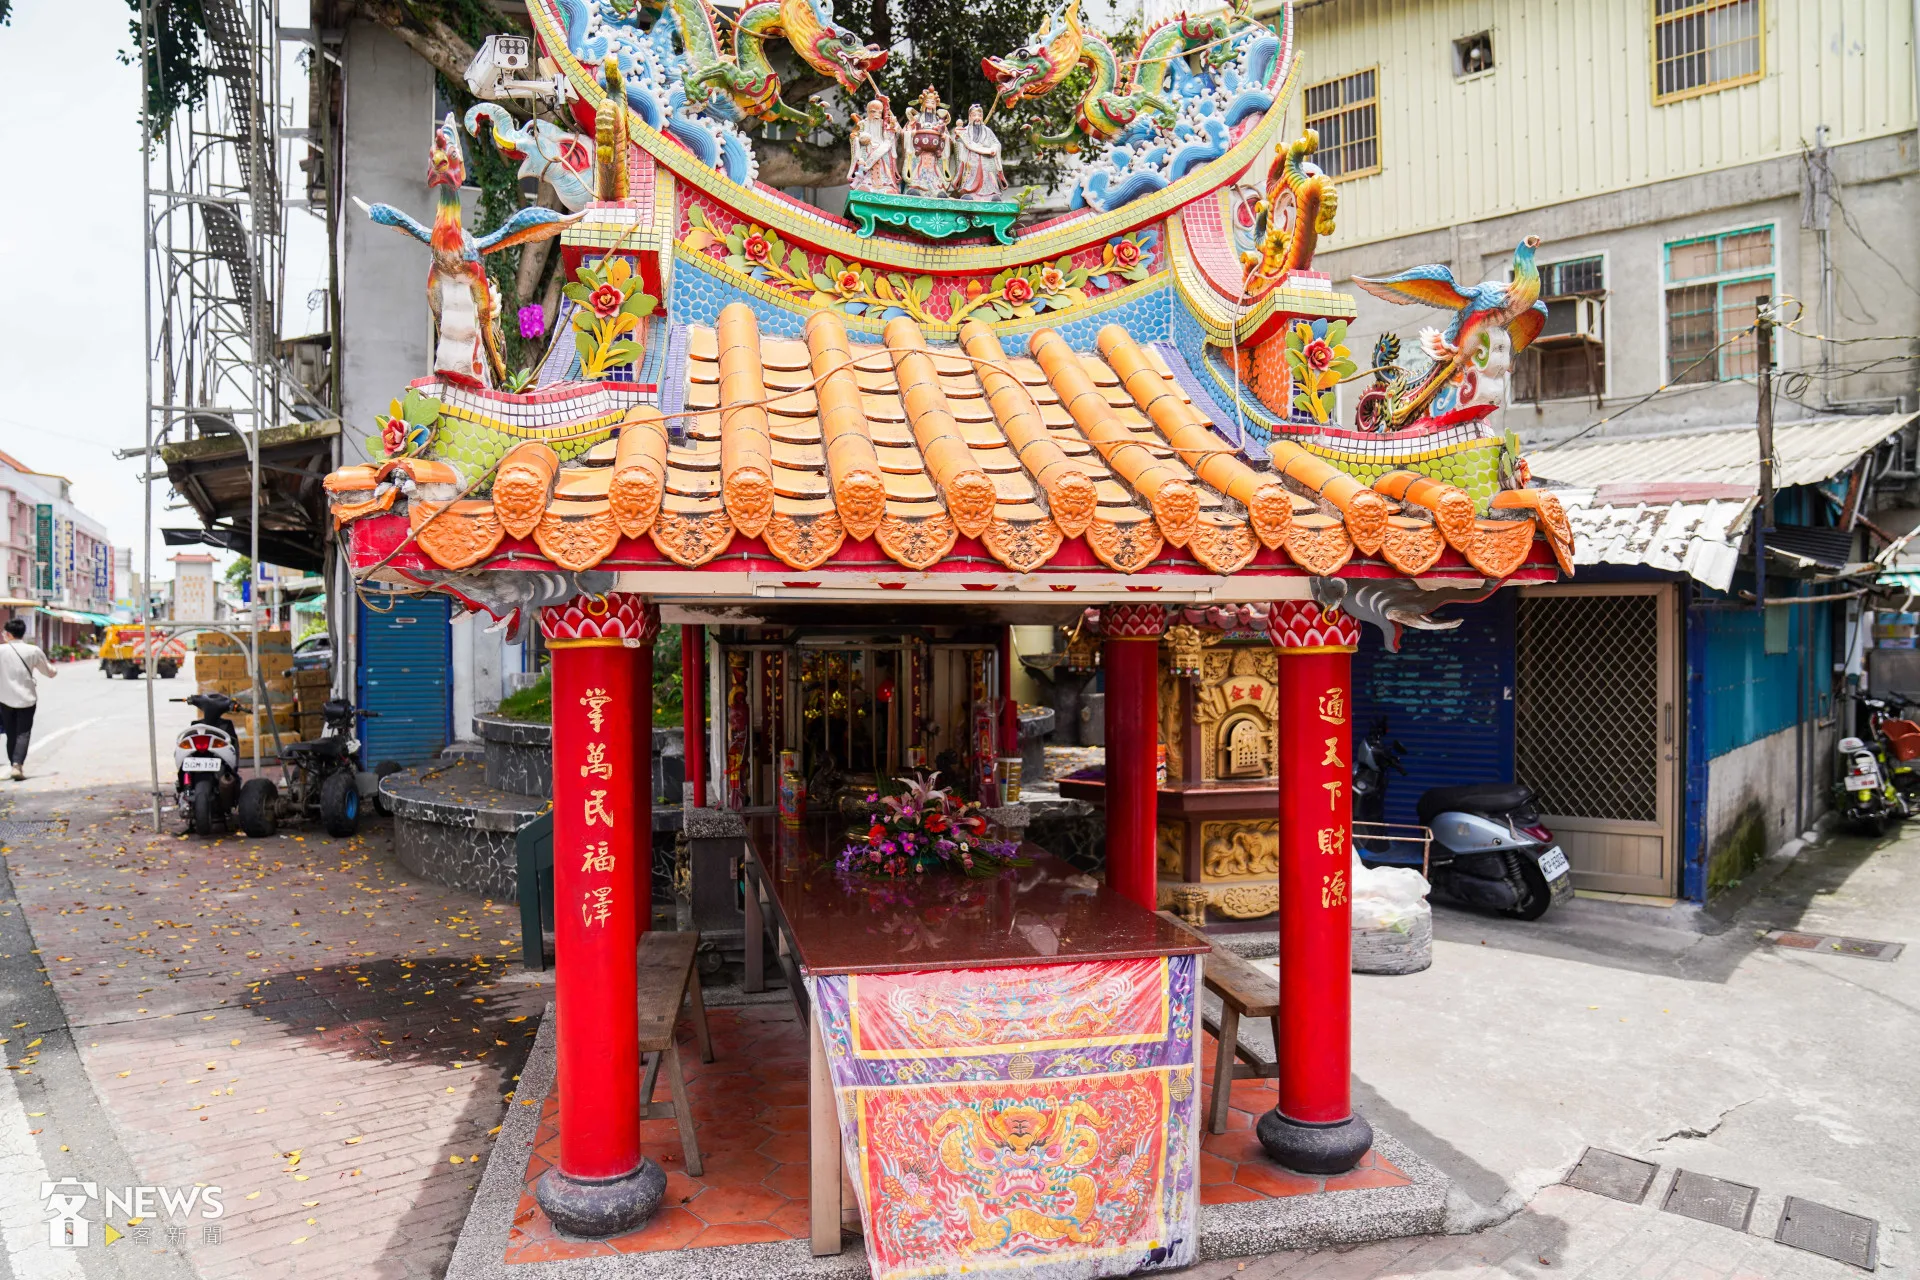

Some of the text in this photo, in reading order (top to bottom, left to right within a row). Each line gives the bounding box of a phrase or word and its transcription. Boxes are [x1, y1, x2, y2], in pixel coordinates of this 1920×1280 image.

[579, 688, 616, 929] 掌萬民福澤
[1317, 687, 1348, 909] 通天下財源
